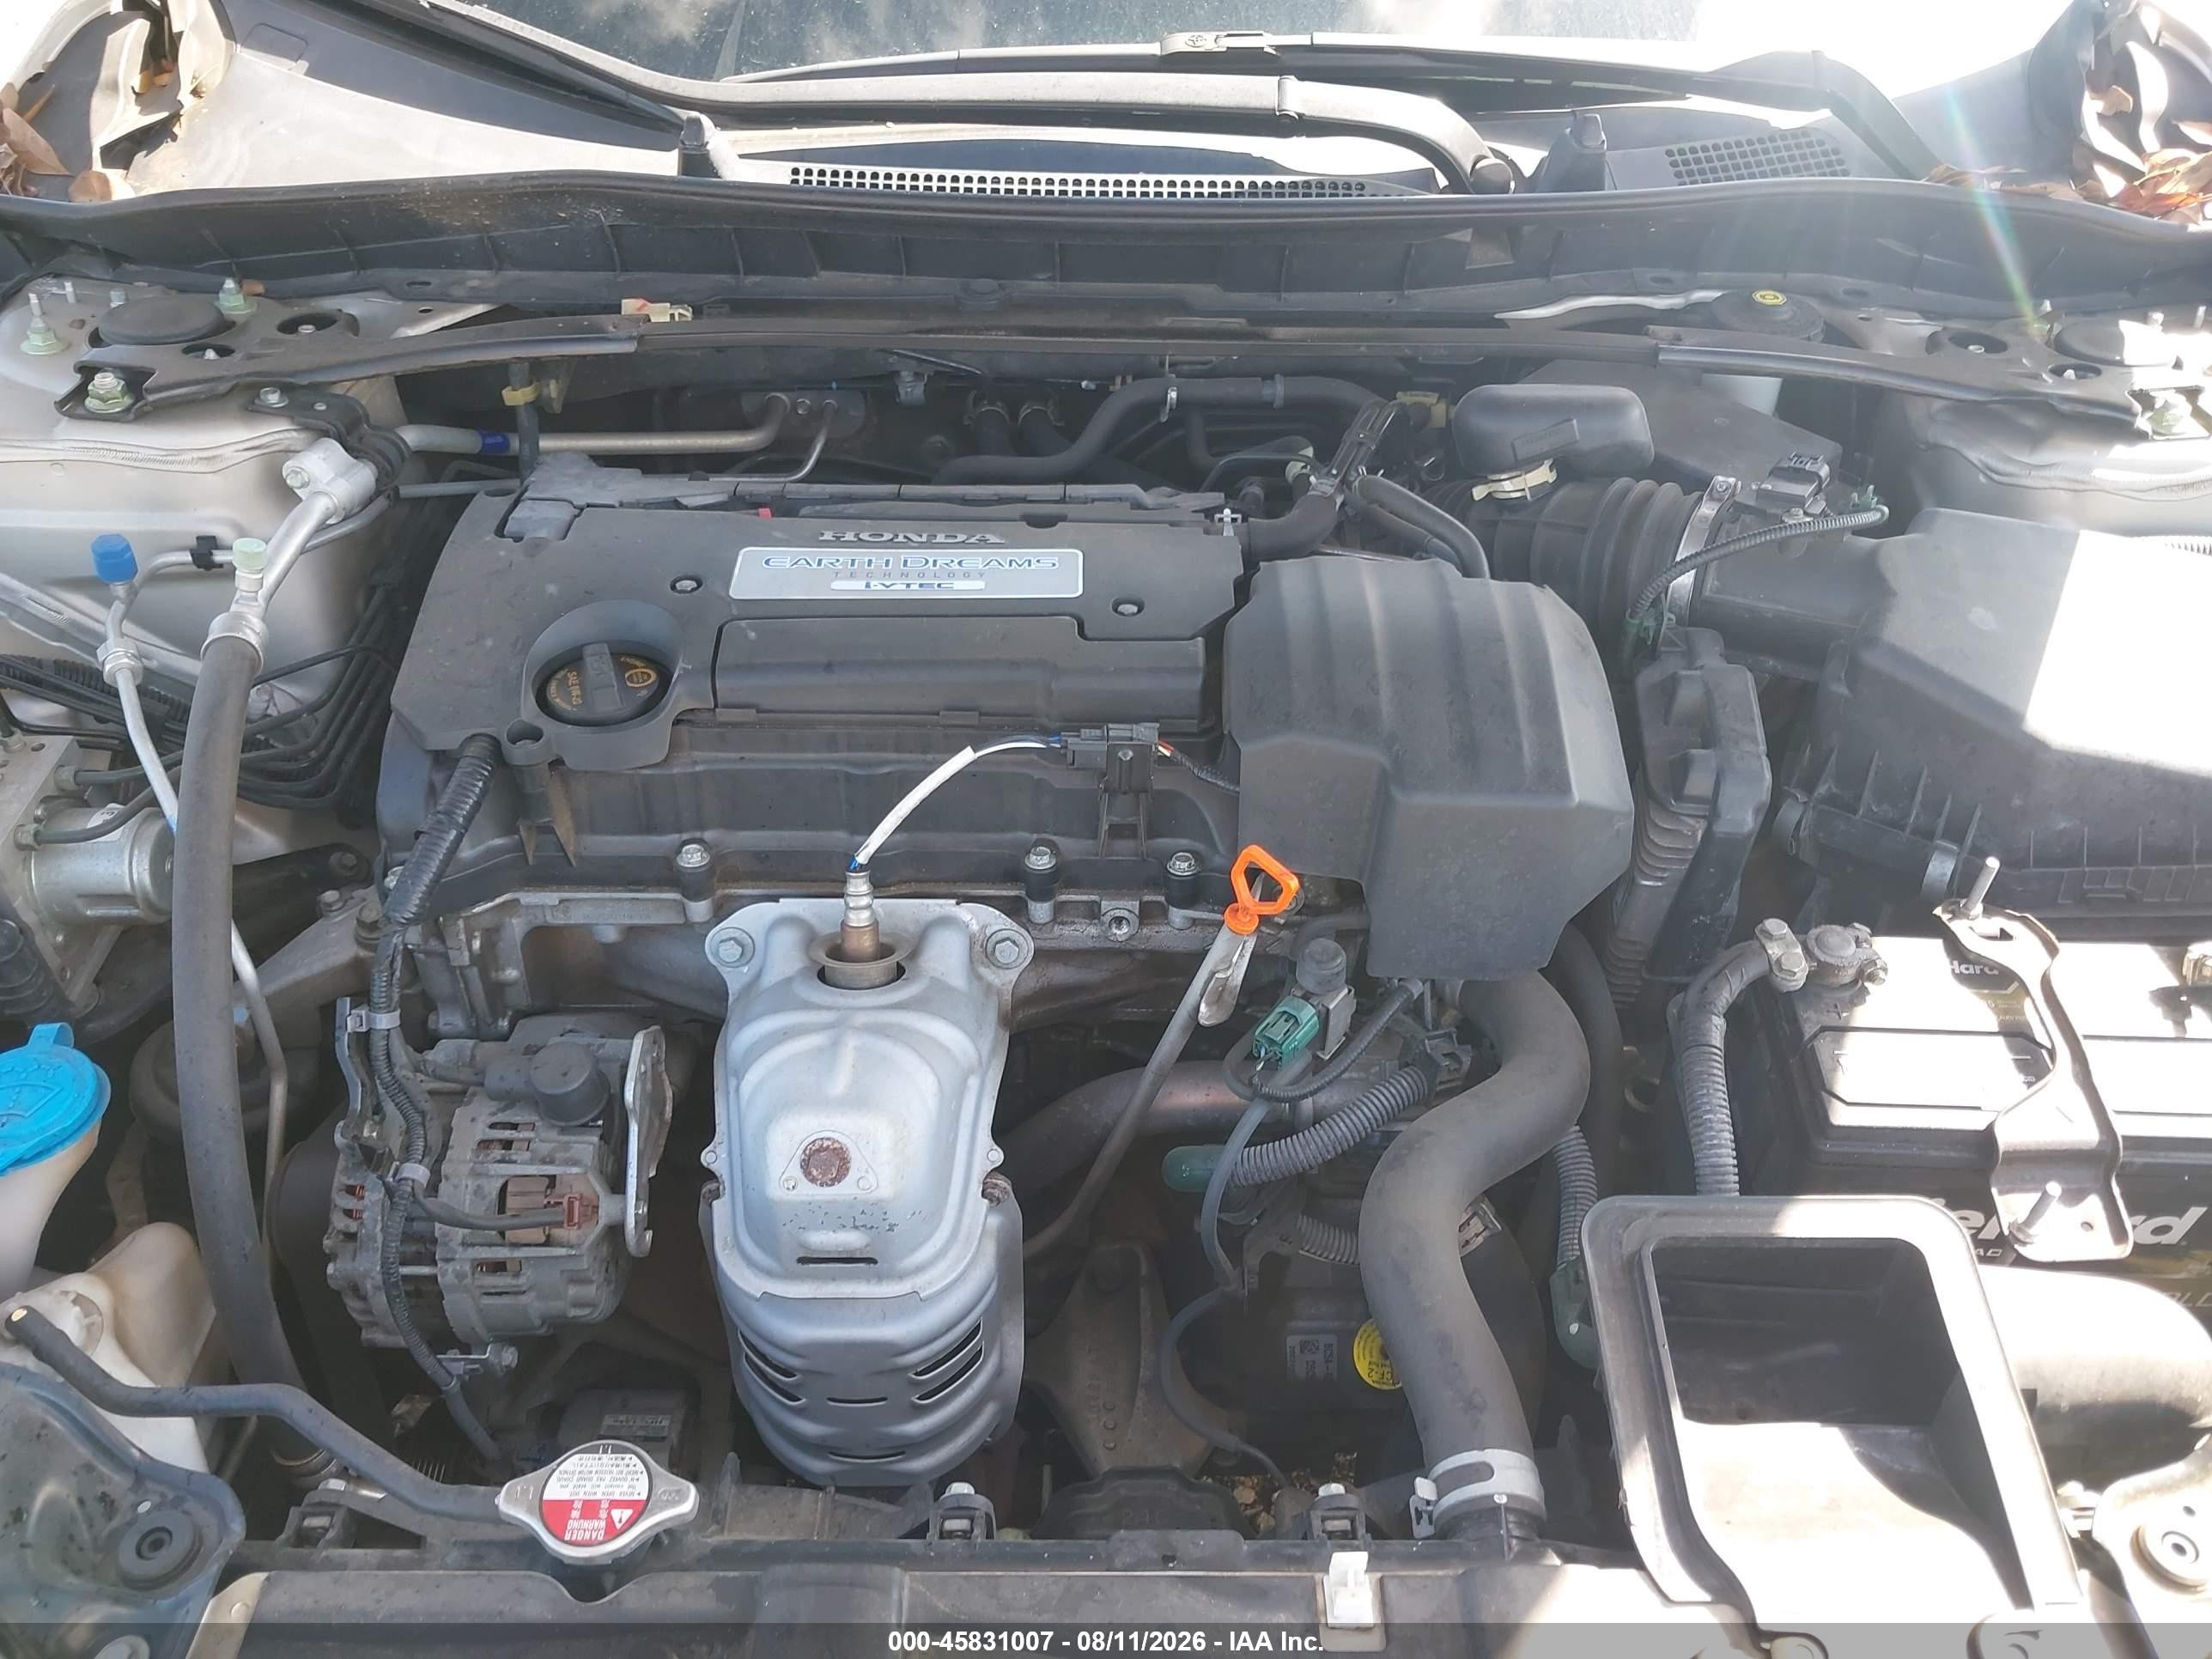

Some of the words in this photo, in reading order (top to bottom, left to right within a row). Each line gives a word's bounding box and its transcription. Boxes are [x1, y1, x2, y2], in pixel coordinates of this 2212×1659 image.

[818, 530, 1005, 544] HONDA
[762, 556, 891, 570] EARTH
[900, 556, 1059, 570] DREAMS
[833, 571, 988, 580] TECHNOLOGY
[563, 1530, 605, 1540] DANGER
